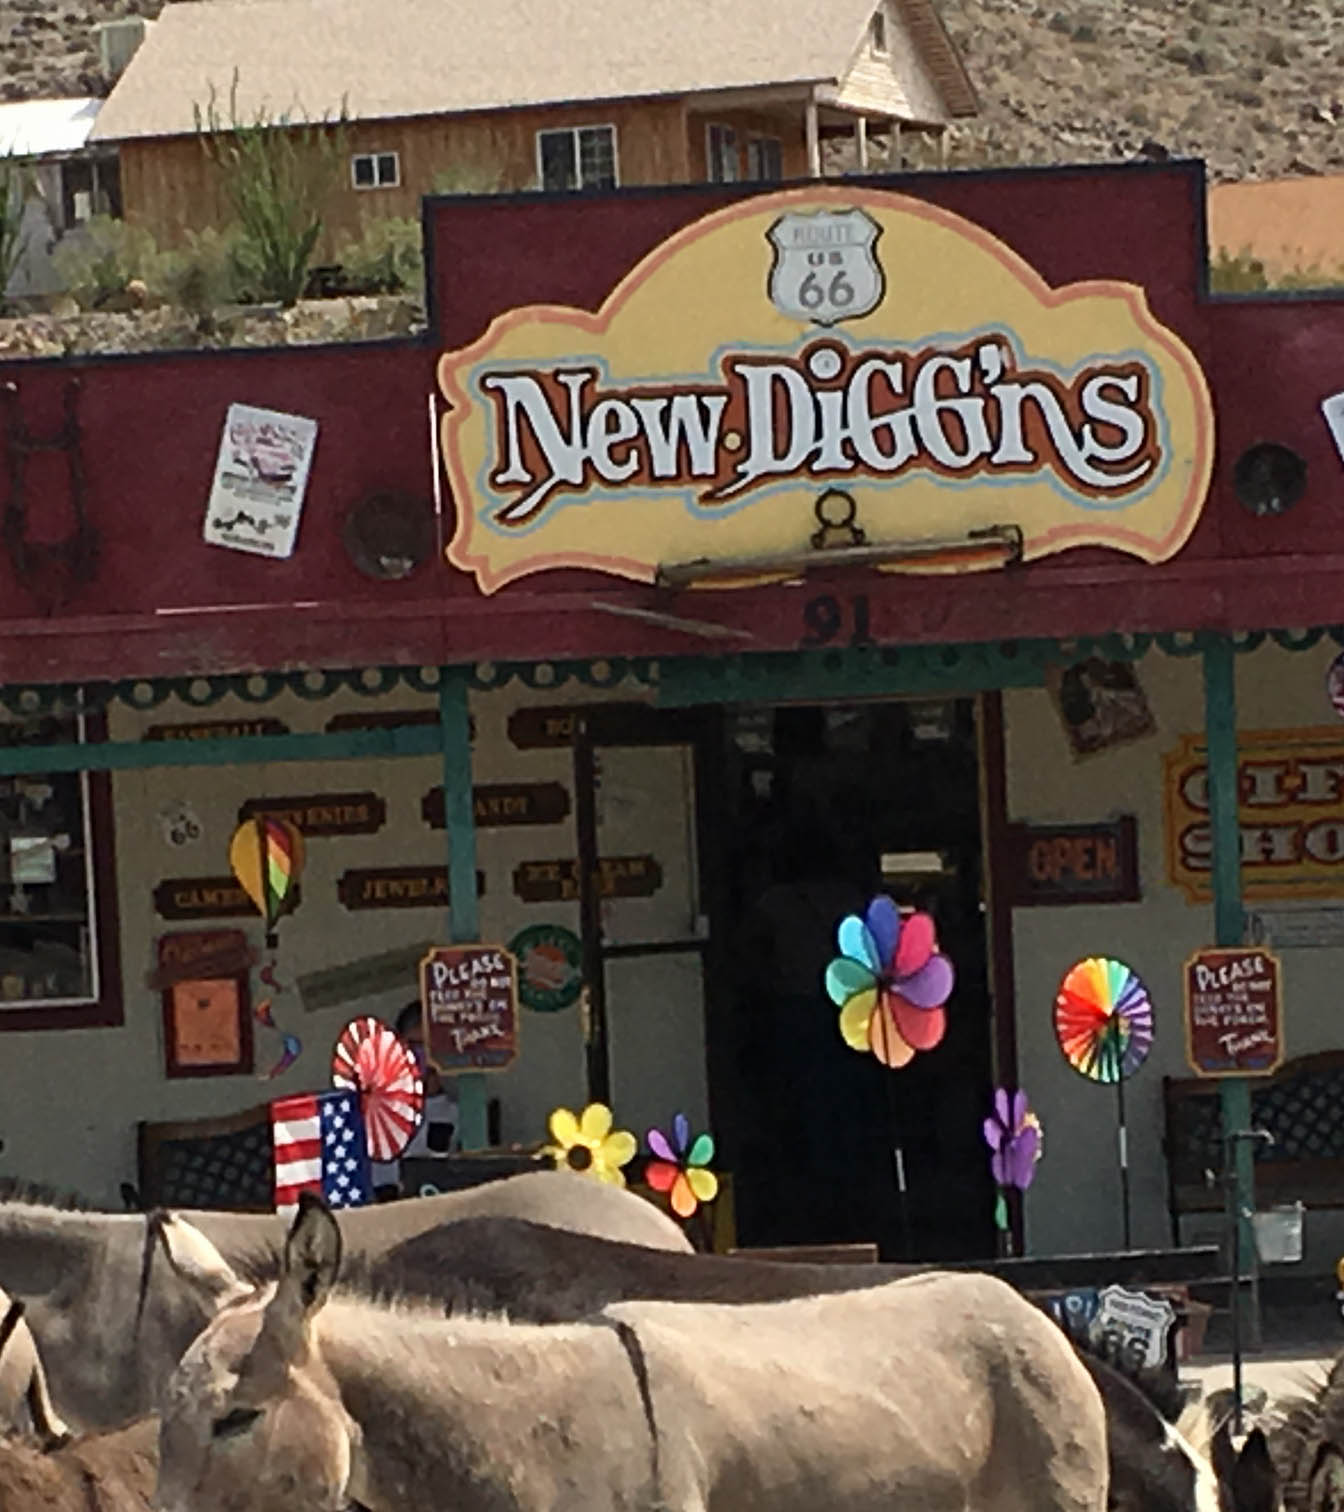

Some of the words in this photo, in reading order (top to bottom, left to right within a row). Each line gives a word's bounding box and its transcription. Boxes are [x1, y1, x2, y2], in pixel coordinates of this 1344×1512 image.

[799, 270, 854, 308] 66
[1027, 837, 1116, 881] OPEN
[432, 953, 505, 988] PLEASE
[1195, 955, 1264, 992] PLEASE
